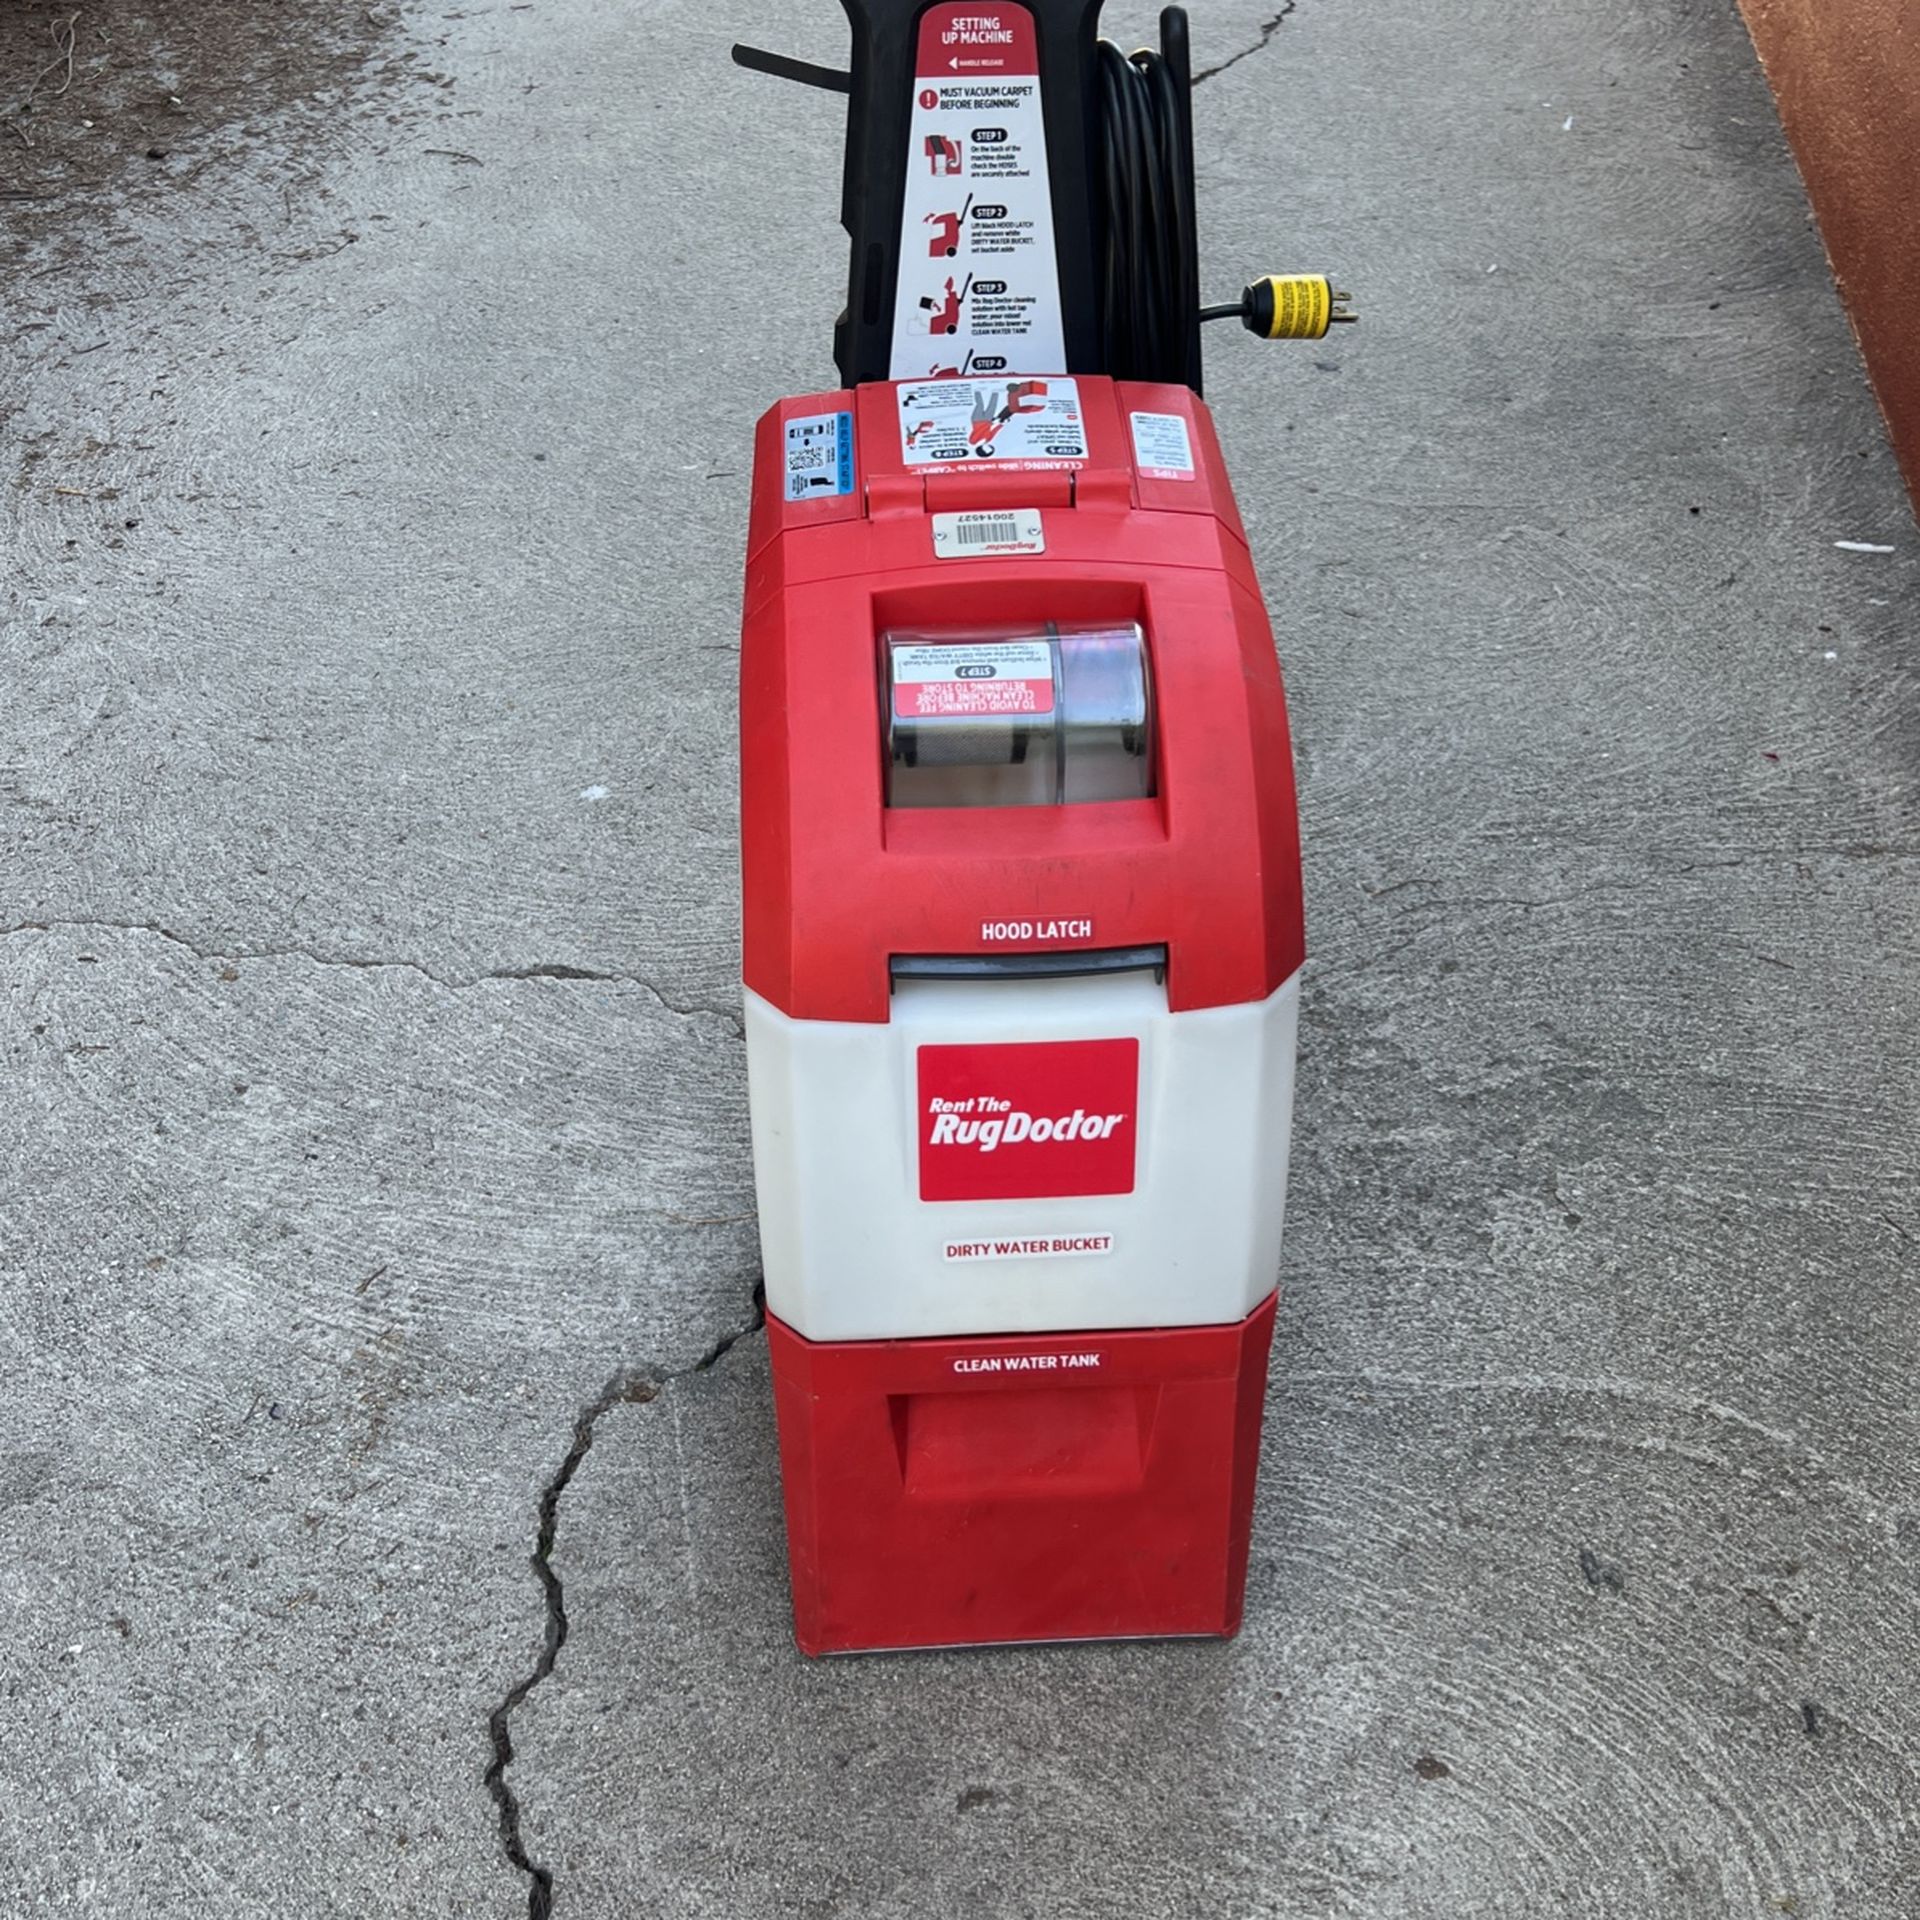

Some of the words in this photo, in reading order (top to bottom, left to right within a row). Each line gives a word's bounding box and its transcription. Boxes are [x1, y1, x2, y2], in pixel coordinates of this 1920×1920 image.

[952, 17, 1000, 31] SETTING
[942, 32, 958, 44] UP
[961, 30, 1013, 44] MACHINE
[940, 87, 962, 97] MUST
[964, 87, 999, 97] VACUUM
[1001, 86, 1033, 96] CARPET
[940, 99, 972, 110] BEFORE
[974, 98, 1020, 109] BEGINNING
[976, 131, 996, 140] STEP
[976, 208, 996, 217] STEP
[997, 208, 1003, 217] 2
[976, 284, 996, 293] STEP
[997, 284, 1003, 292] 3
[976, 360, 996, 368] STEP
[968, 463, 995, 472] switch
[1025, 461, 1083, 470] CLEANING
[1153, 469, 1178, 479] TIPS
[958, 513, 1014, 522] 20014527
[985, 542, 1036, 550] RugDoctor
[968, 667, 991, 676] STEP
[922, 683, 953, 693] STORE
[954, 682, 968, 692] TO
[970, 681, 1026, 692] RETURNING
[916, 693, 954, 705] BEFORE
[955, 691, 1000, 702] MACHINE
[1003, 690, 1035, 701] CLEAN
[939, 701, 988, 712] CLEANING
[989, 700, 1021, 710] AVOID
[1022, 699, 1035, 709] TO
[982, 922, 1032, 940] HOOD
[1037, 920, 1091, 938] LATCH
[929, 1097, 975, 1113] Rent
[977, 1097, 1011, 1112] The
[929, 1109, 1124, 1152] RugDoctor
[947, 1243, 991, 1257] DIRTY
[994, 1240, 1049, 1255] WATER
[1052, 1237, 1111, 1252] BUCKET
[954, 1358, 1001, 1372] CLEAN
[1004, 1356, 1057, 1370] WATER
[1060, 1354, 1100, 1368] TANK
